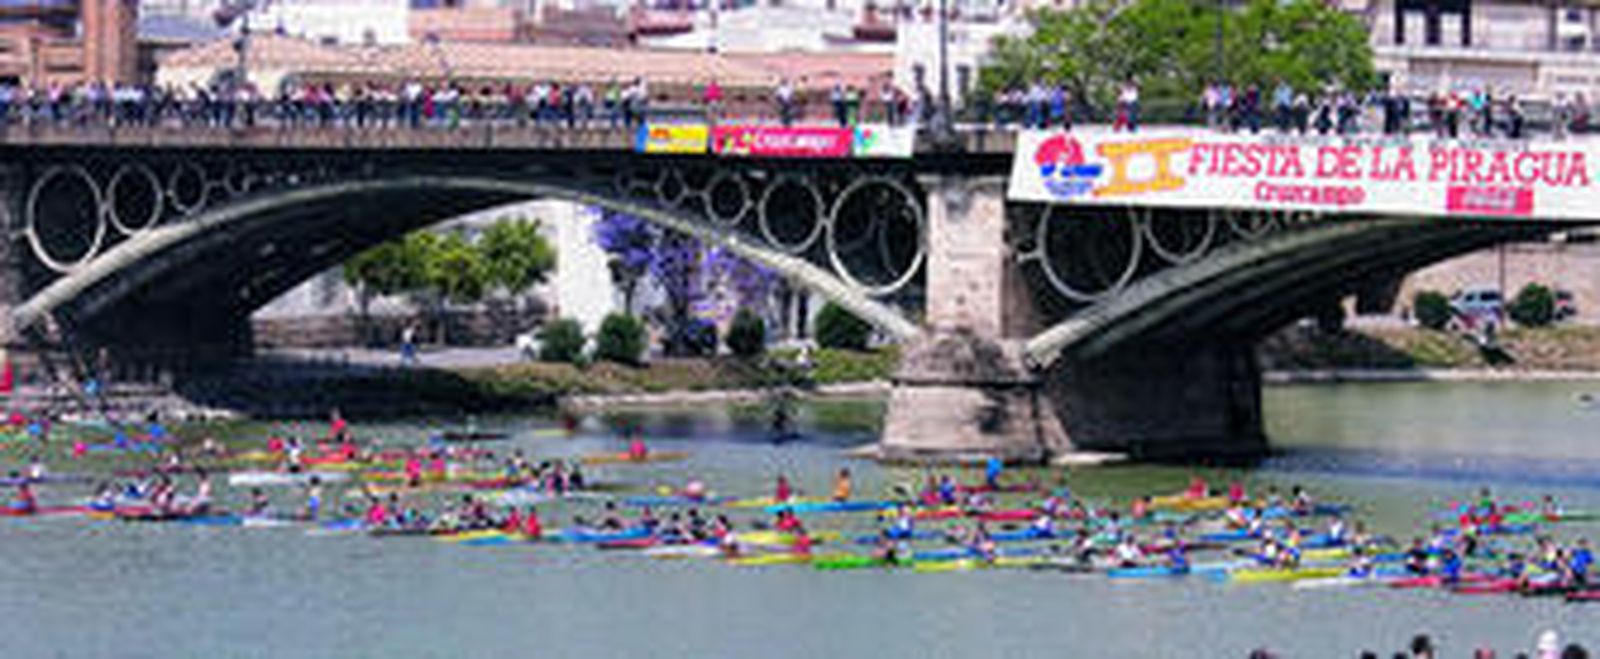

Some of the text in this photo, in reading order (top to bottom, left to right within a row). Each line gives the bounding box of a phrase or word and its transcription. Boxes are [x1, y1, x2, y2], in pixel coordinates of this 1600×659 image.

[1188, 142, 1304, 177] FIESTA
[1315, 146, 1363, 179] DE
[1369, 146, 1417, 181] LA
[1427, 147, 1589, 187] PIRAGUA
